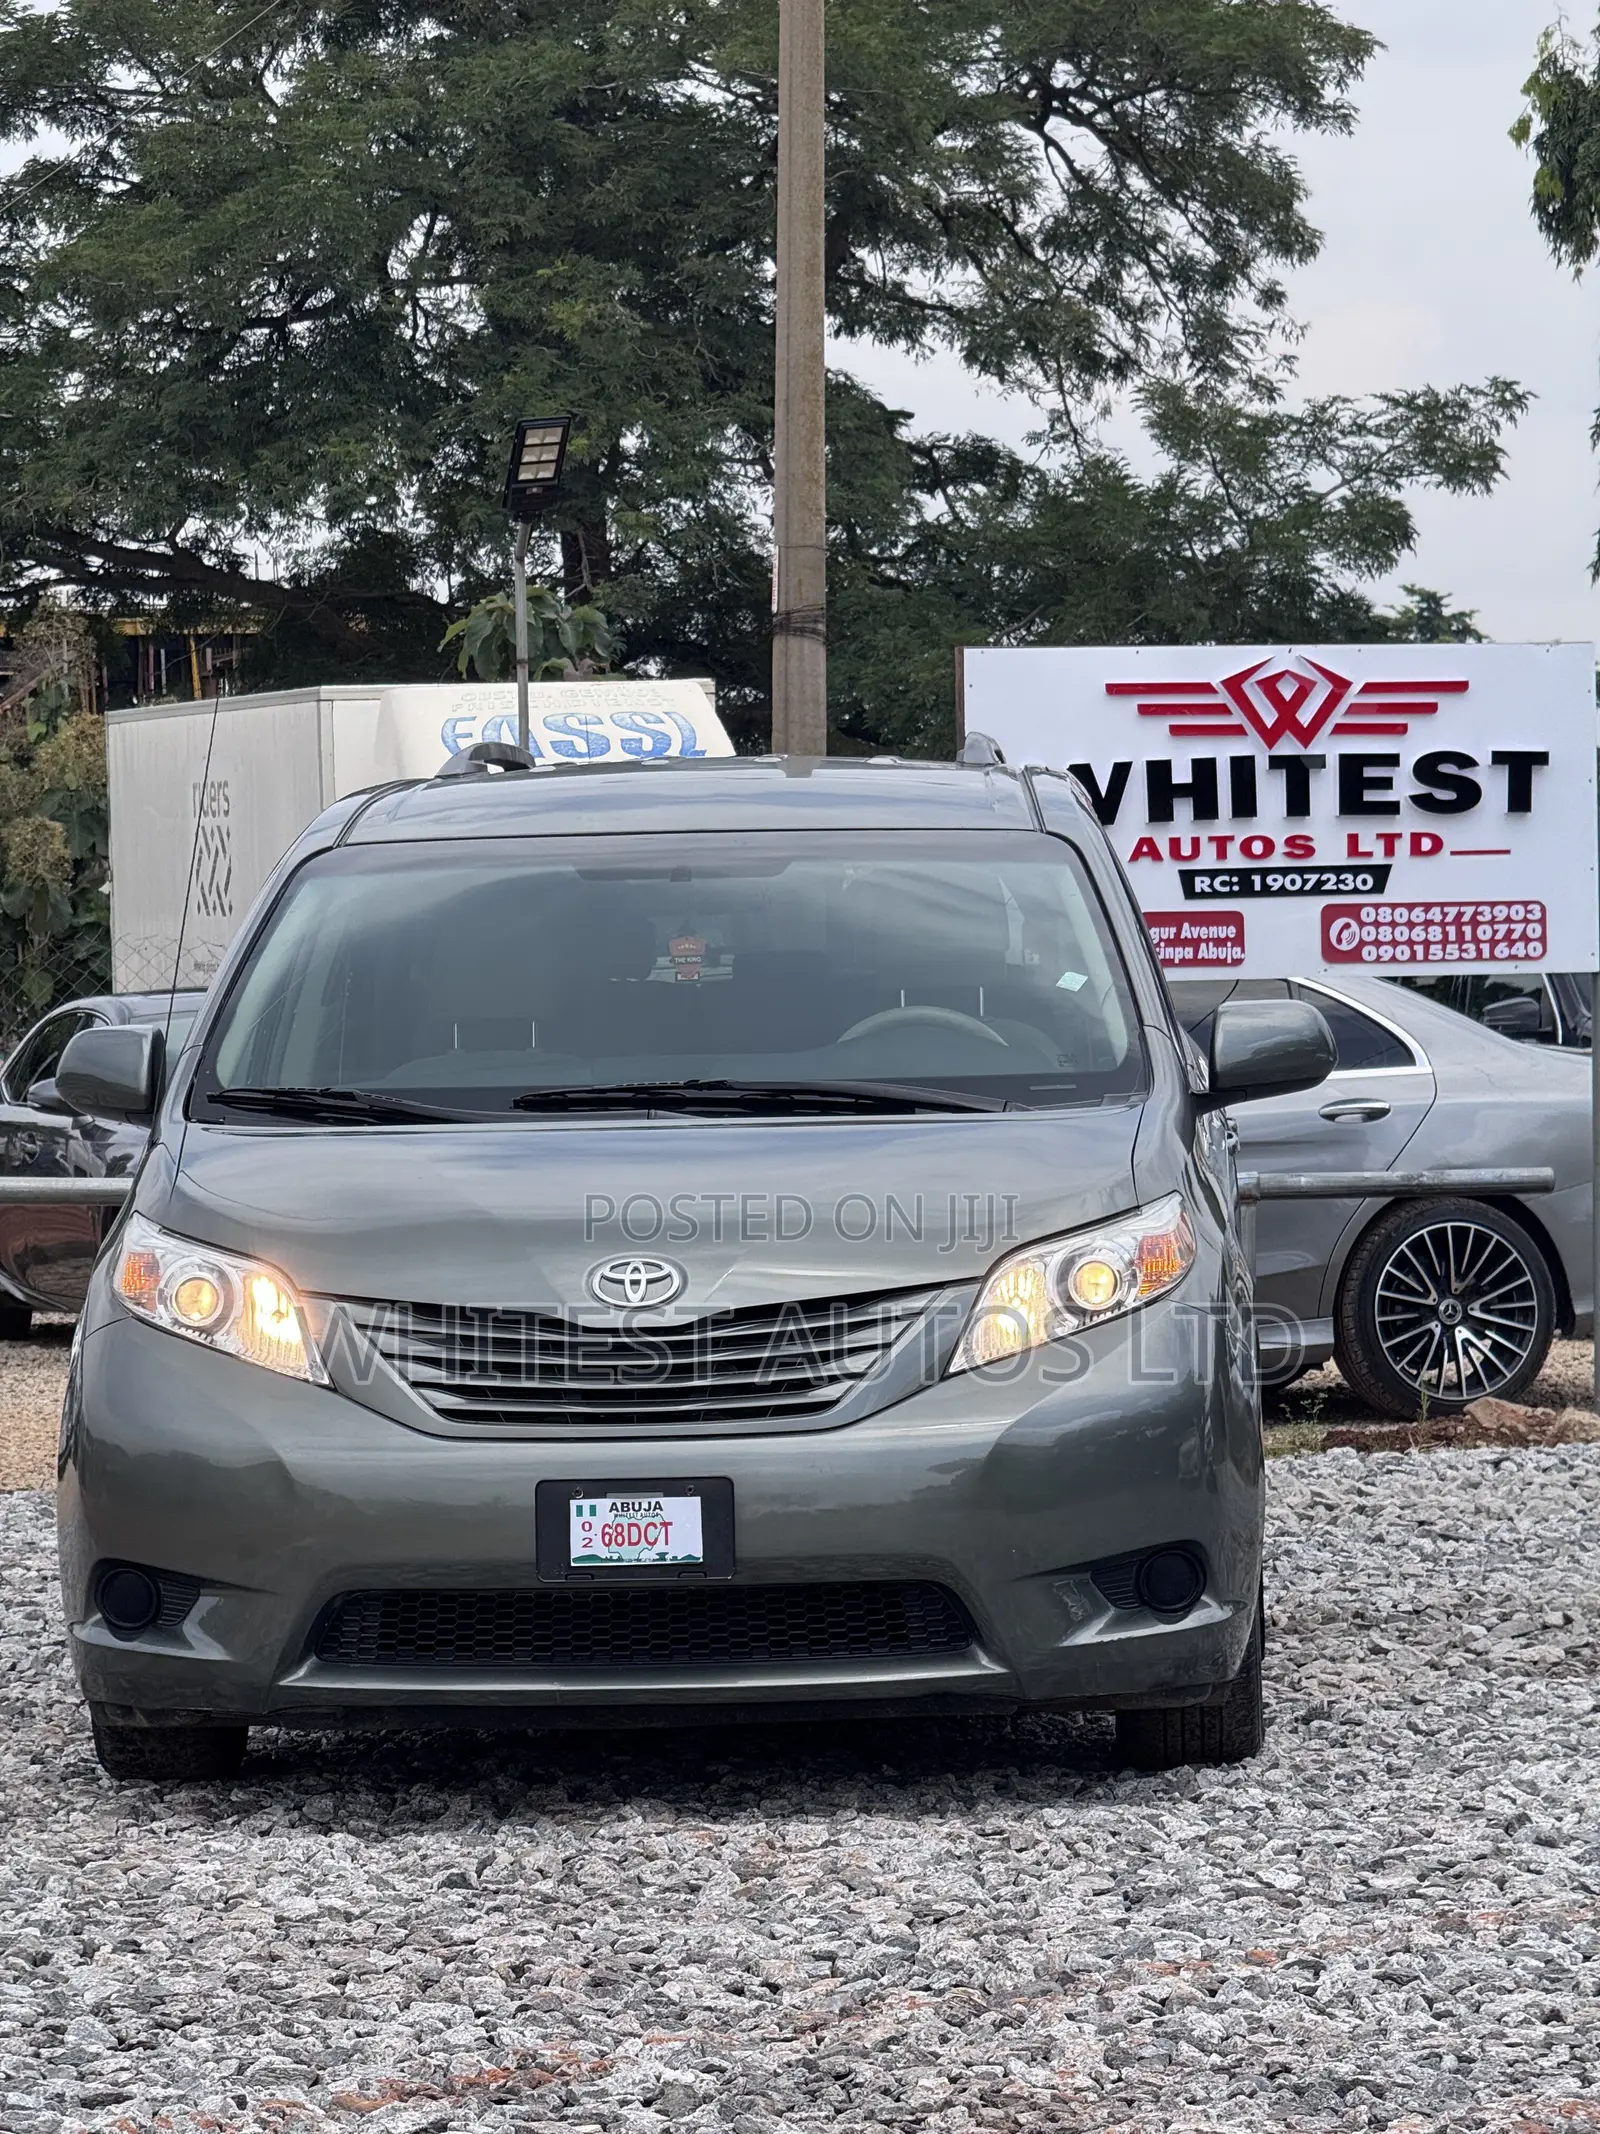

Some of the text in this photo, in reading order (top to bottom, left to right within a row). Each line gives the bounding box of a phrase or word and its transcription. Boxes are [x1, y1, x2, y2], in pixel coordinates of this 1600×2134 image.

[1128, 831, 1444, 863] AUTOS LTD
[1194, 872, 1374, 894] RC: 1907230
[1360, 904, 1542, 923] 08064773903
[1180, 922, 1236, 939] Avenue
[1361, 922, 1543, 942] 08068110770
[1197, 942, 1245, 963] Abuja.
[1362, 941, 1543, 961] 09015531640
[609, 1501, 664, 1513] ABUJA
[601, 1522, 673, 1548] 68DCT
